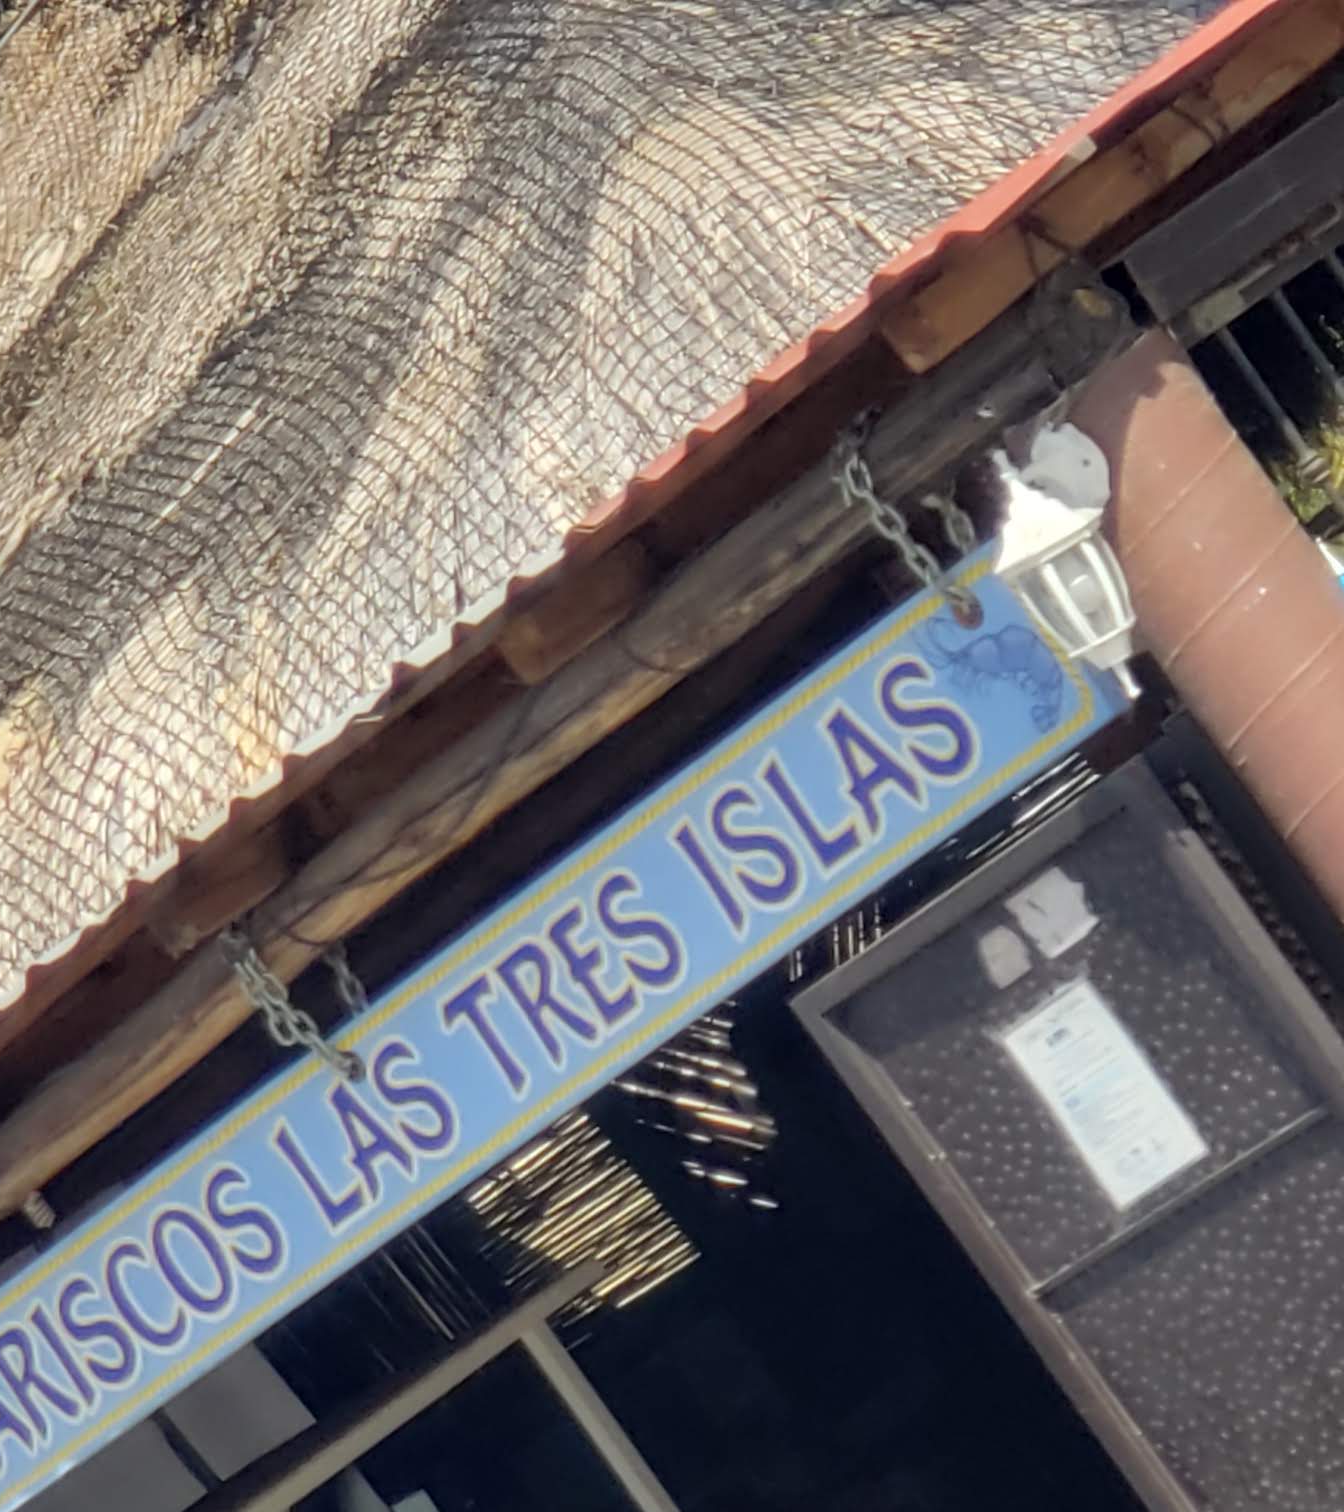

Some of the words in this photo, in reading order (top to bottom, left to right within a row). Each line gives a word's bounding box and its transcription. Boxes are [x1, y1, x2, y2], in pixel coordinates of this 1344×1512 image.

[275, 1039, 456, 1227] LAS
[442, 872, 682, 1092] TRES
[674, 660, 976, 928] ISLAS
